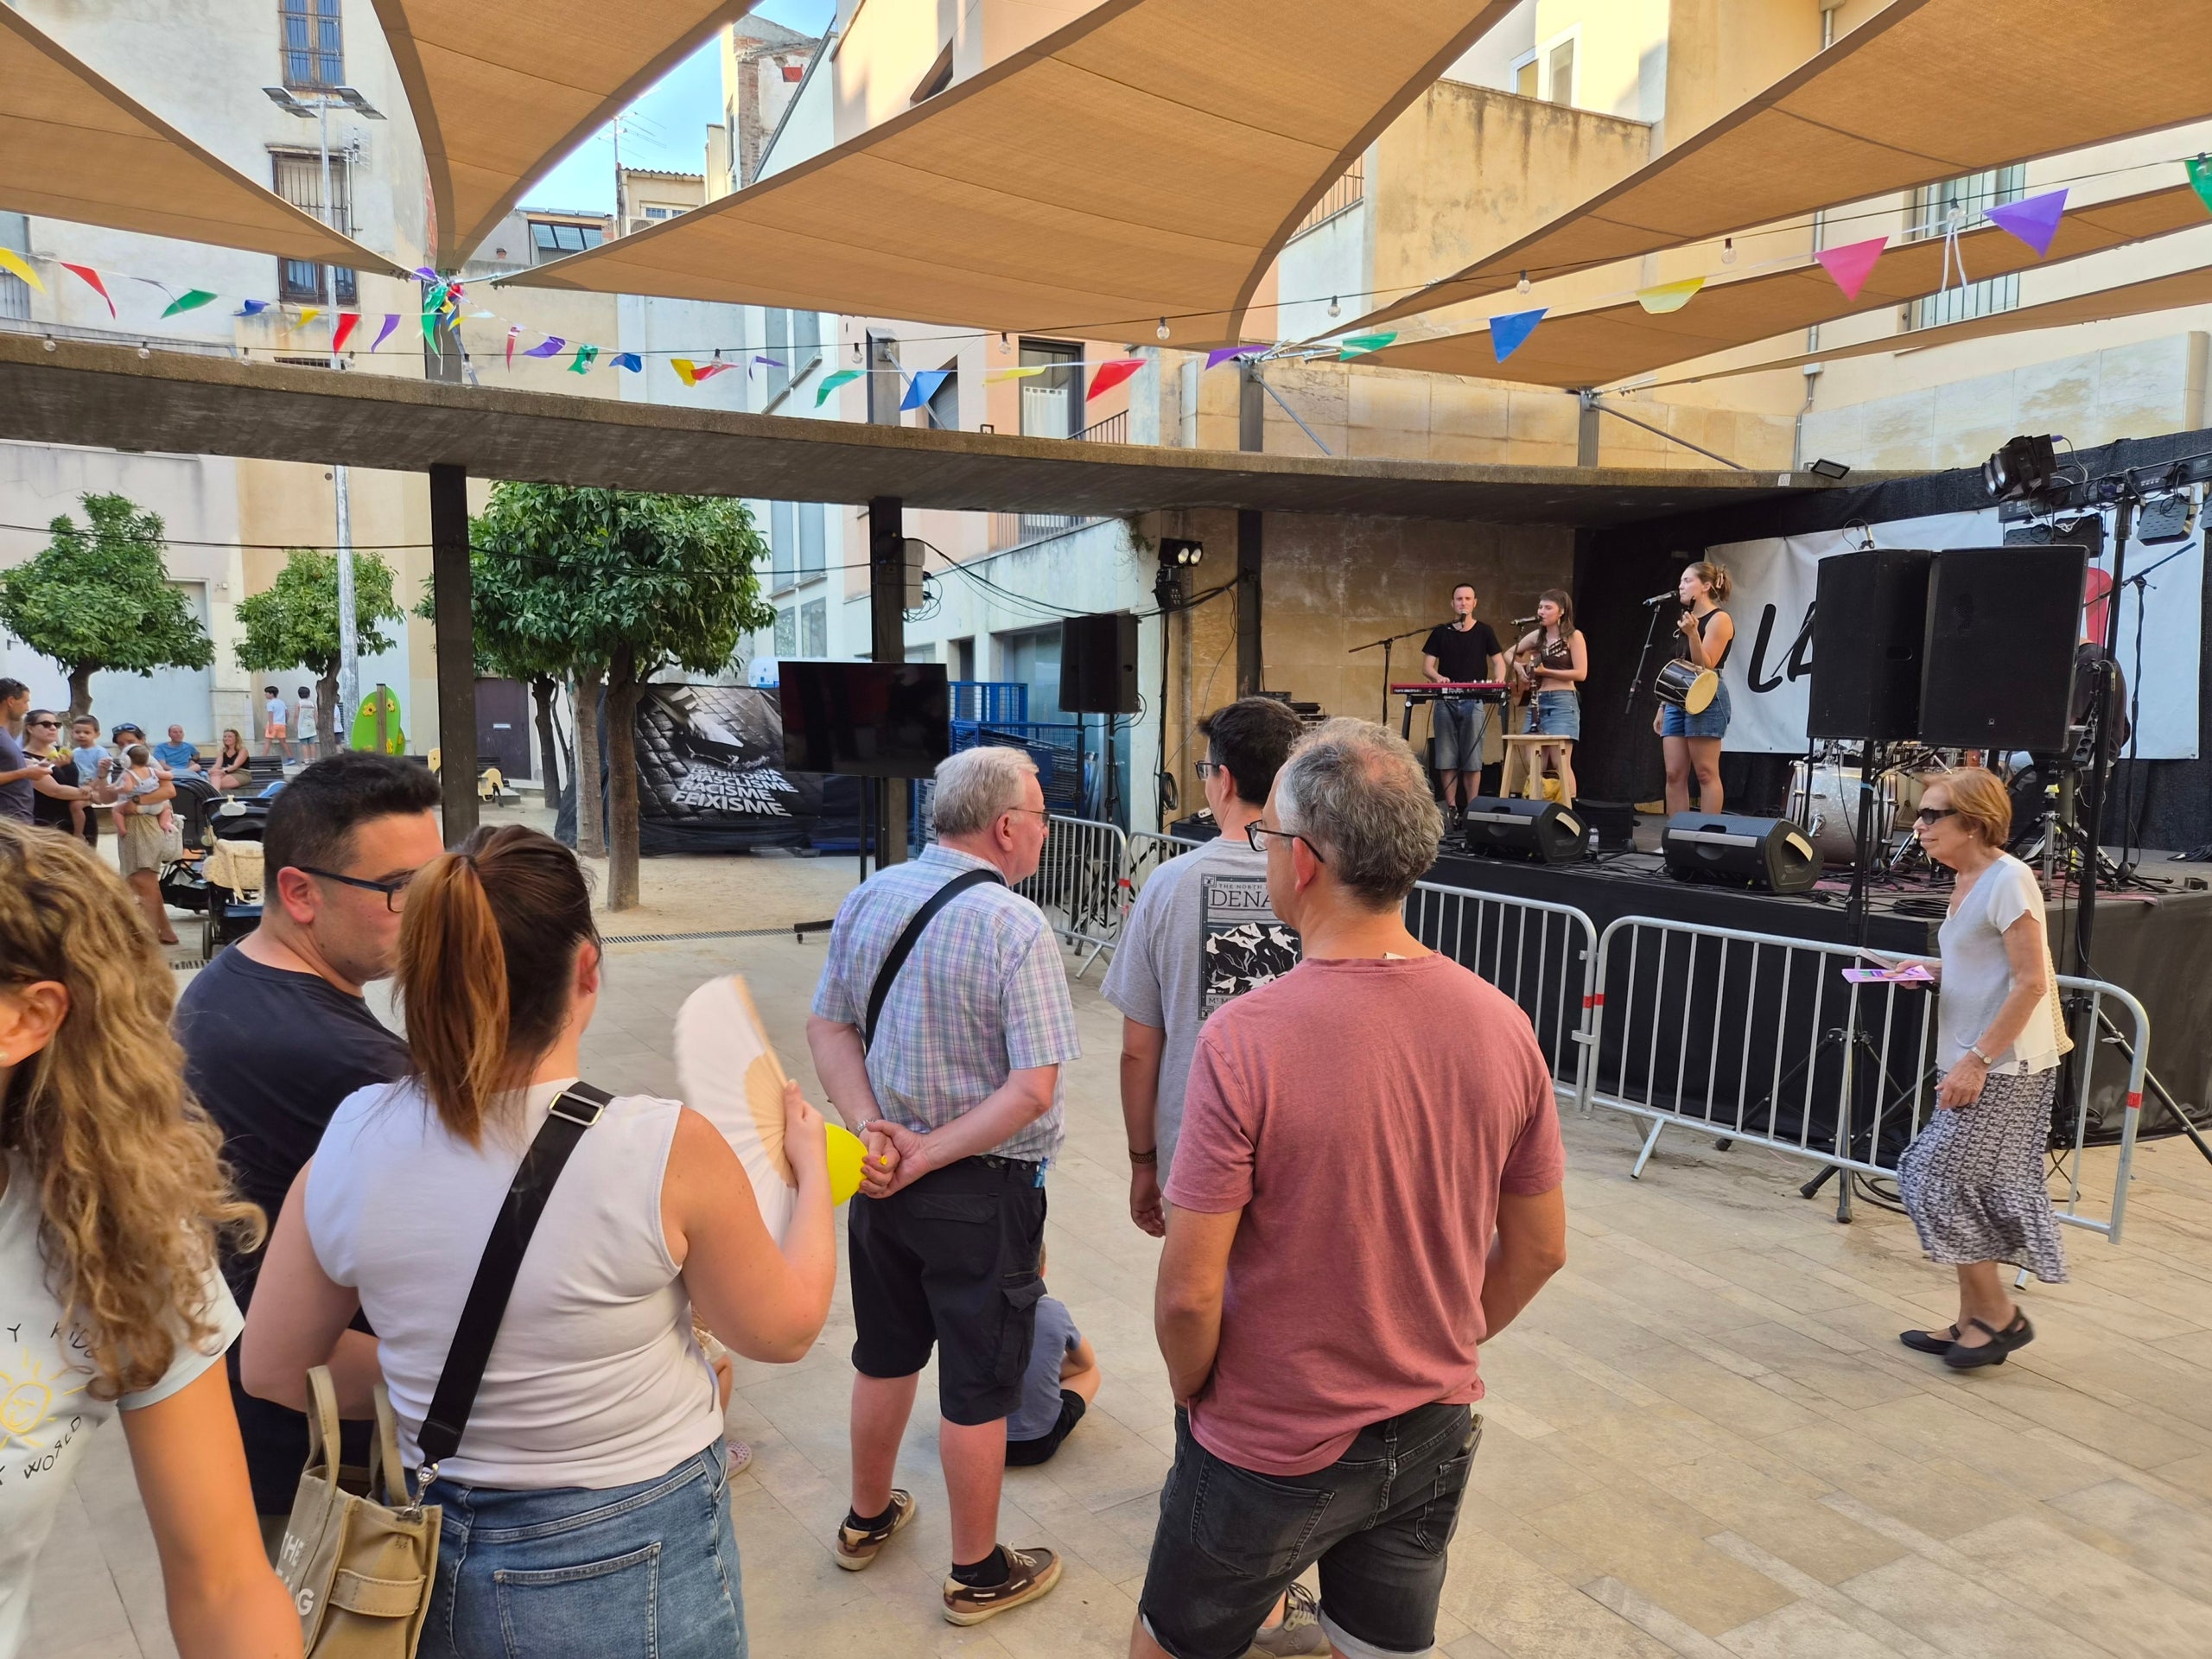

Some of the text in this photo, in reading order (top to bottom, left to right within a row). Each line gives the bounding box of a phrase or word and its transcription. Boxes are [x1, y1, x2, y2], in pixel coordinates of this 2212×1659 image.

[679, 779, 776, 802] RACISME
[686, 772, 799, 793] MASCLISME
[671, 790, 793, 817] FEIXISME
[23, 1416, 82, 1479] WORLD
